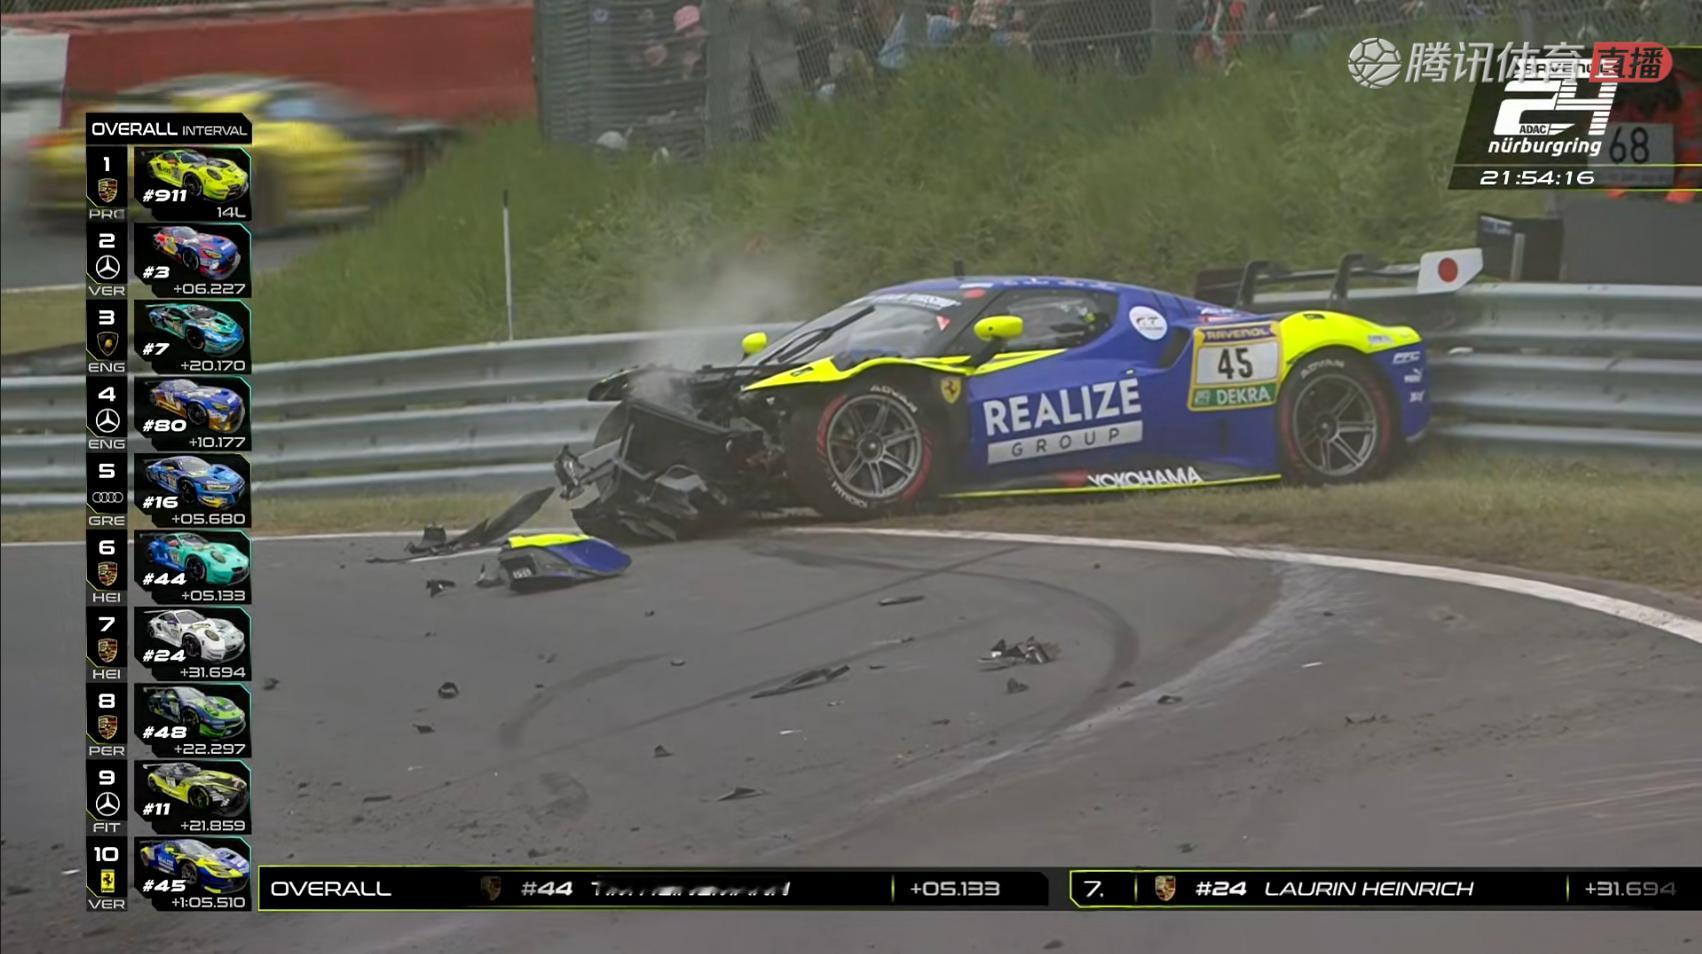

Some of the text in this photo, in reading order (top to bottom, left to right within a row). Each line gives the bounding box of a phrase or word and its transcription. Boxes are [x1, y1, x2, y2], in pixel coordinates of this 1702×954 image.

[1609, 126, 1649, 163] 68
[1206, 328, 1270, 341] RAVENOL
[1218, 348, 1253, 379] 45
[983, 378, 1142, 436] REALIZE
[1216, 386, 1271, 405] DEKRA
[1011, 428, 1120, 457] GROUP
[1087, 466, 1203, 487] YOKOHAMA
